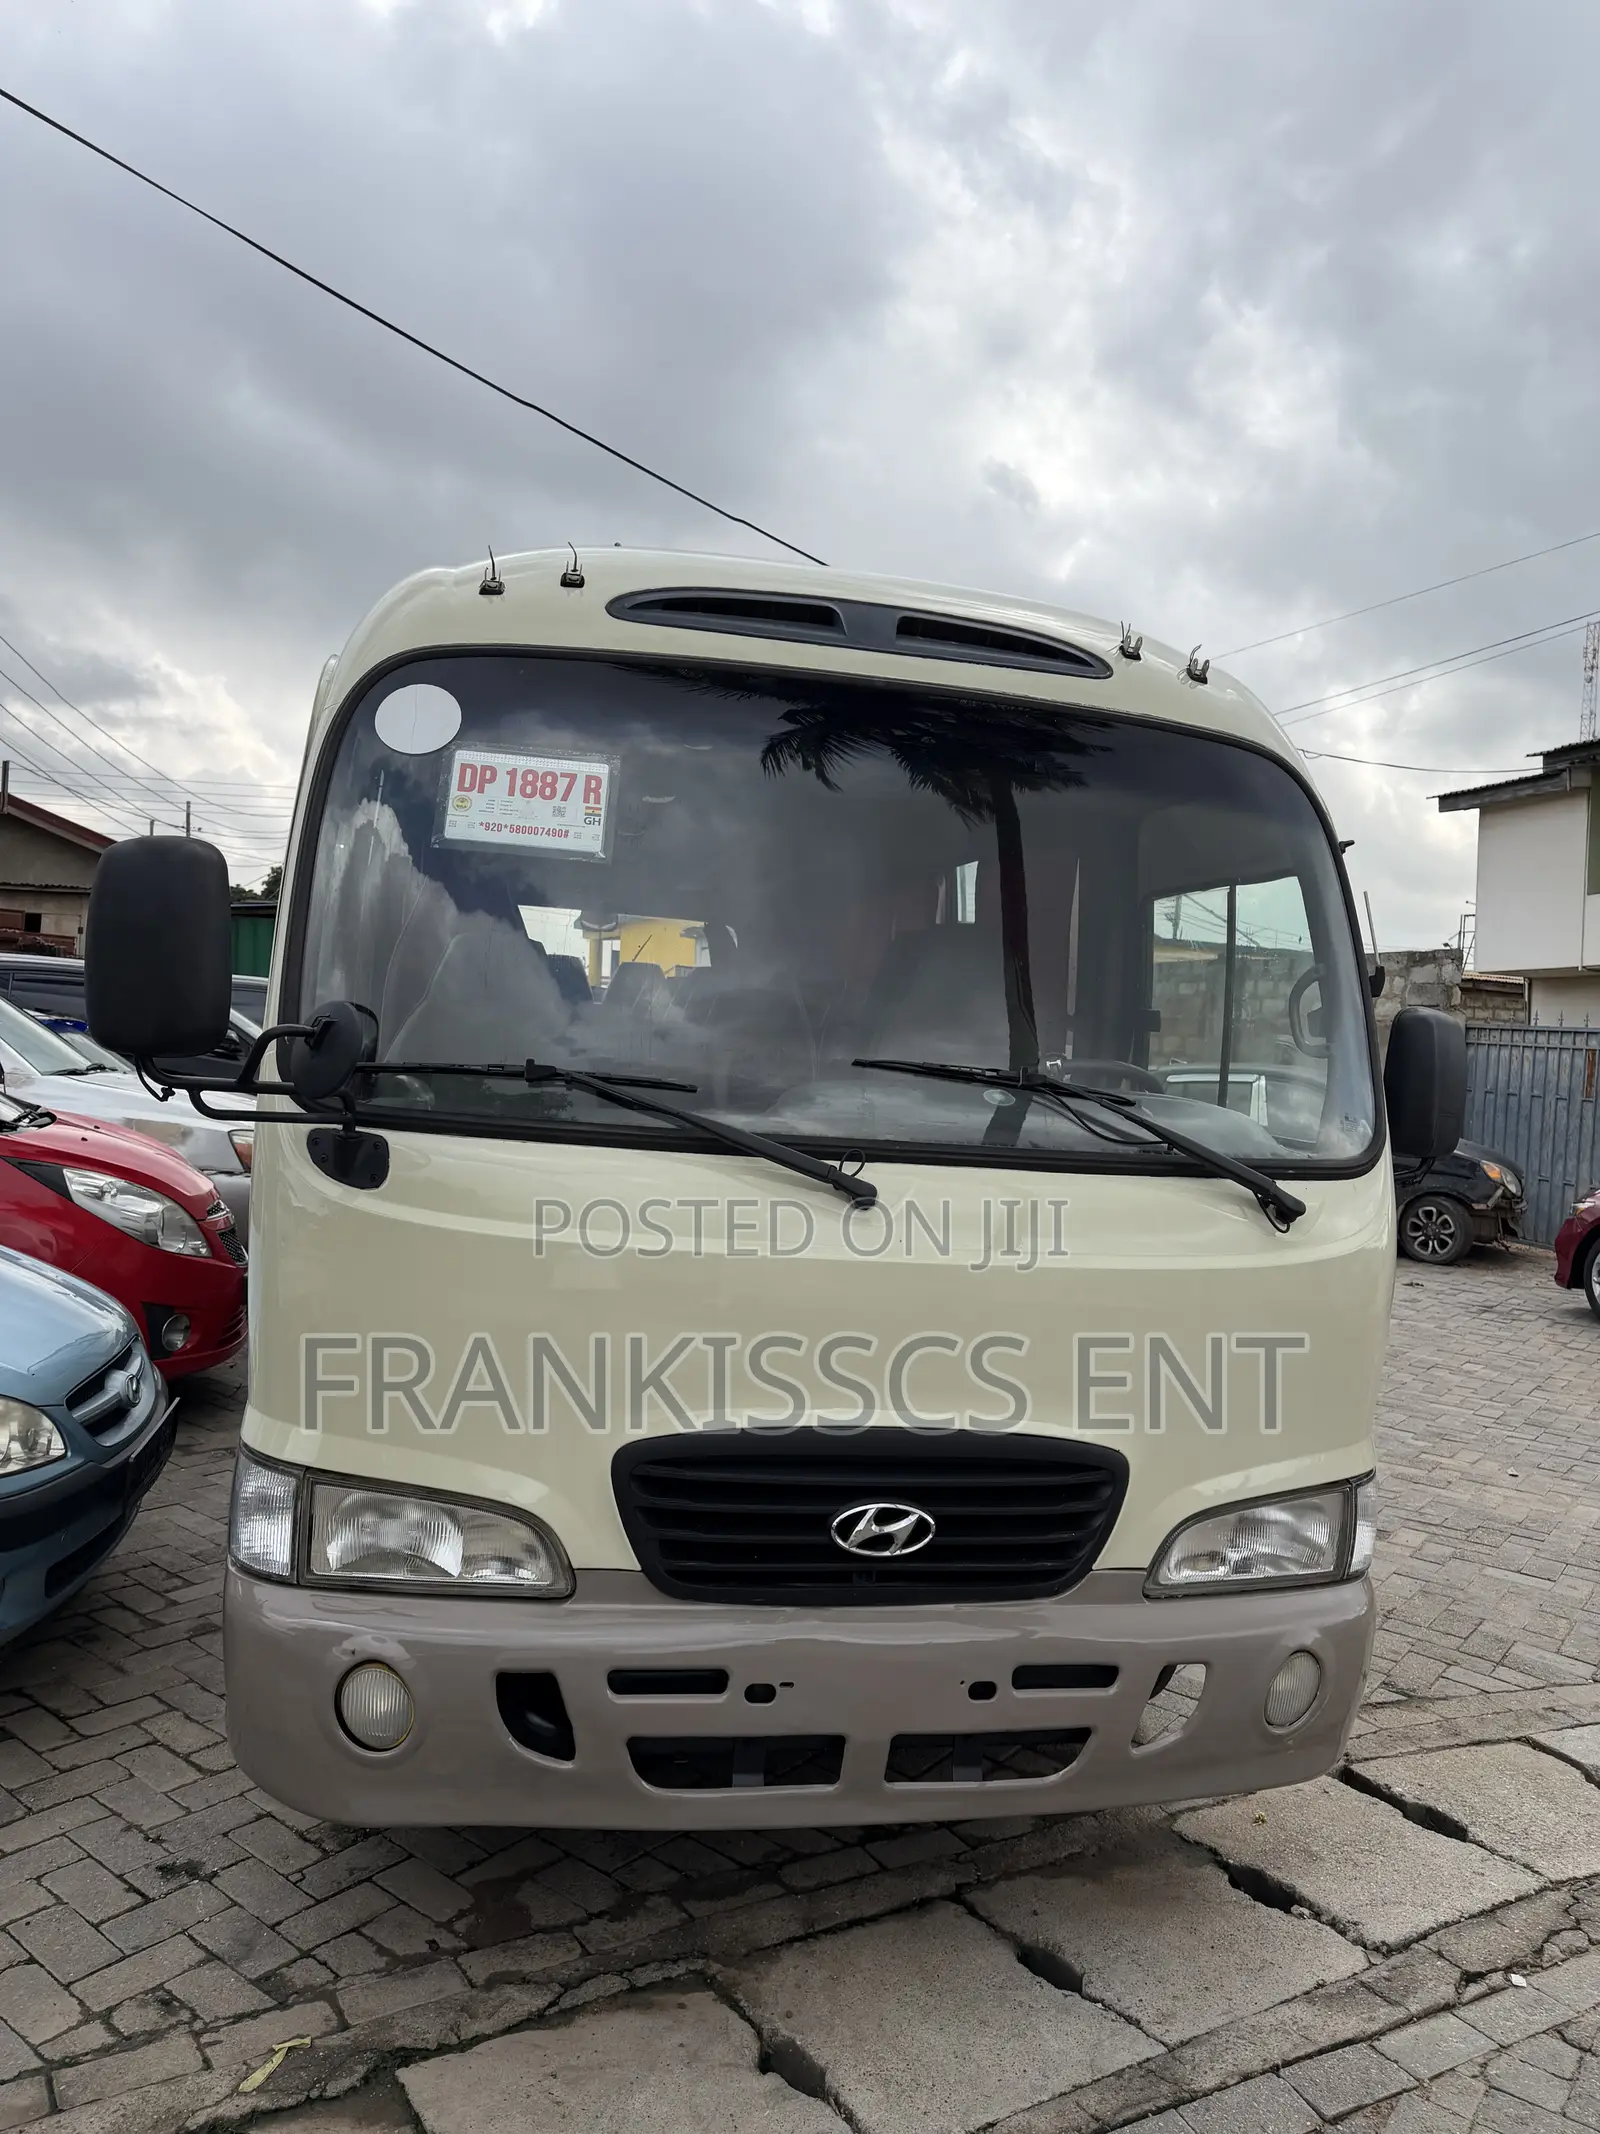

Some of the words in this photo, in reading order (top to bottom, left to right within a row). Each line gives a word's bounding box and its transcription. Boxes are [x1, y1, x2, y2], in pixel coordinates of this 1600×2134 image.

[457, 762, 498, 794] DP
[505, 767, 578, 802] 1887
[583, 774, 603, 805] R
[583, 816, 601, 826] GH
